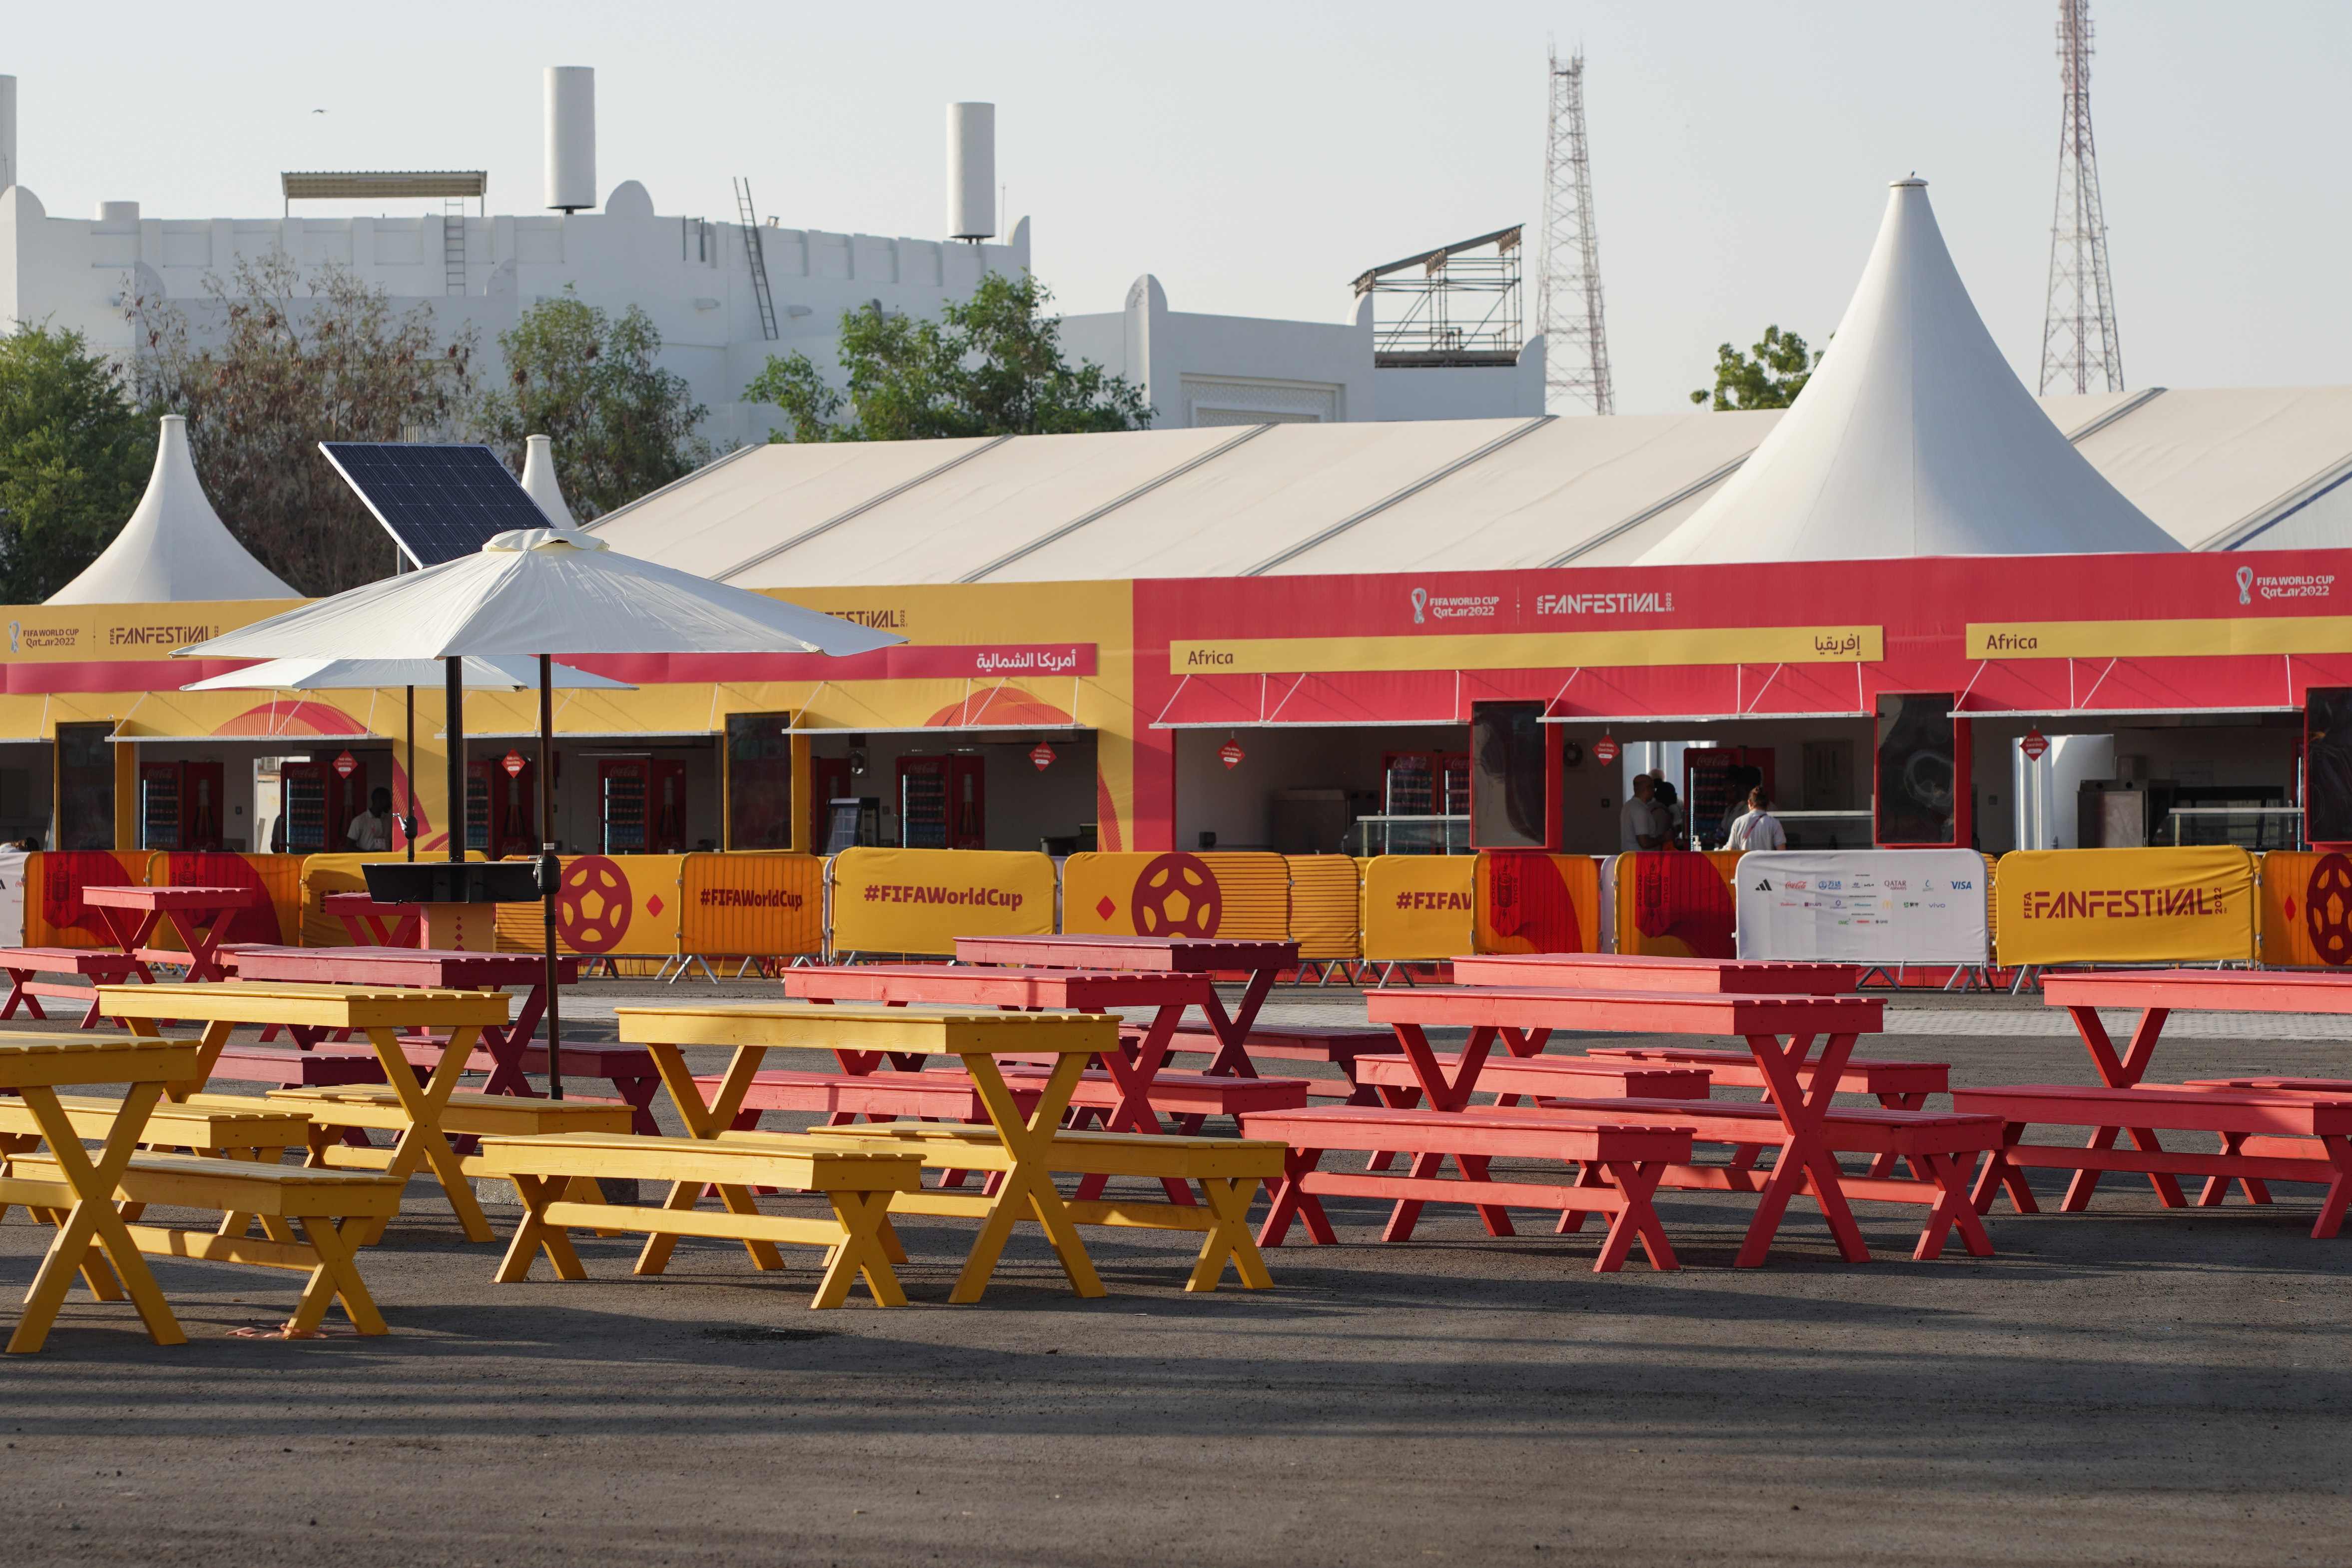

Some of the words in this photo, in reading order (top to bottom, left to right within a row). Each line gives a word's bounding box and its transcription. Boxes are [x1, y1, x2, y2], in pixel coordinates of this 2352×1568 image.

[2257, 577, 2278, 586] FIFA
[2279, 576, 2314, 585] WORLD
[2316, 575, 2335, 584] CUP
[1429, 597, 1448, 606] FIFA
[1449, 597, 1481, 605] WORLD
[1482, 596, 1499, 604] CUP
[1815, 633, 1861, 656] إفريقيا
[1987, 634, 2037, 649] Africa
[976, 652, 1034, 672] الشمالية
[1037, 649, 1076, 671] أمريكا
[1188, 650, 1233, 665] Africa
[1950, 881, 1972, 890] VISA
[700, 889, 803, 912] #FIFAWorldCup
[864, 885, 1023, 911] #FIFAWorldCup
